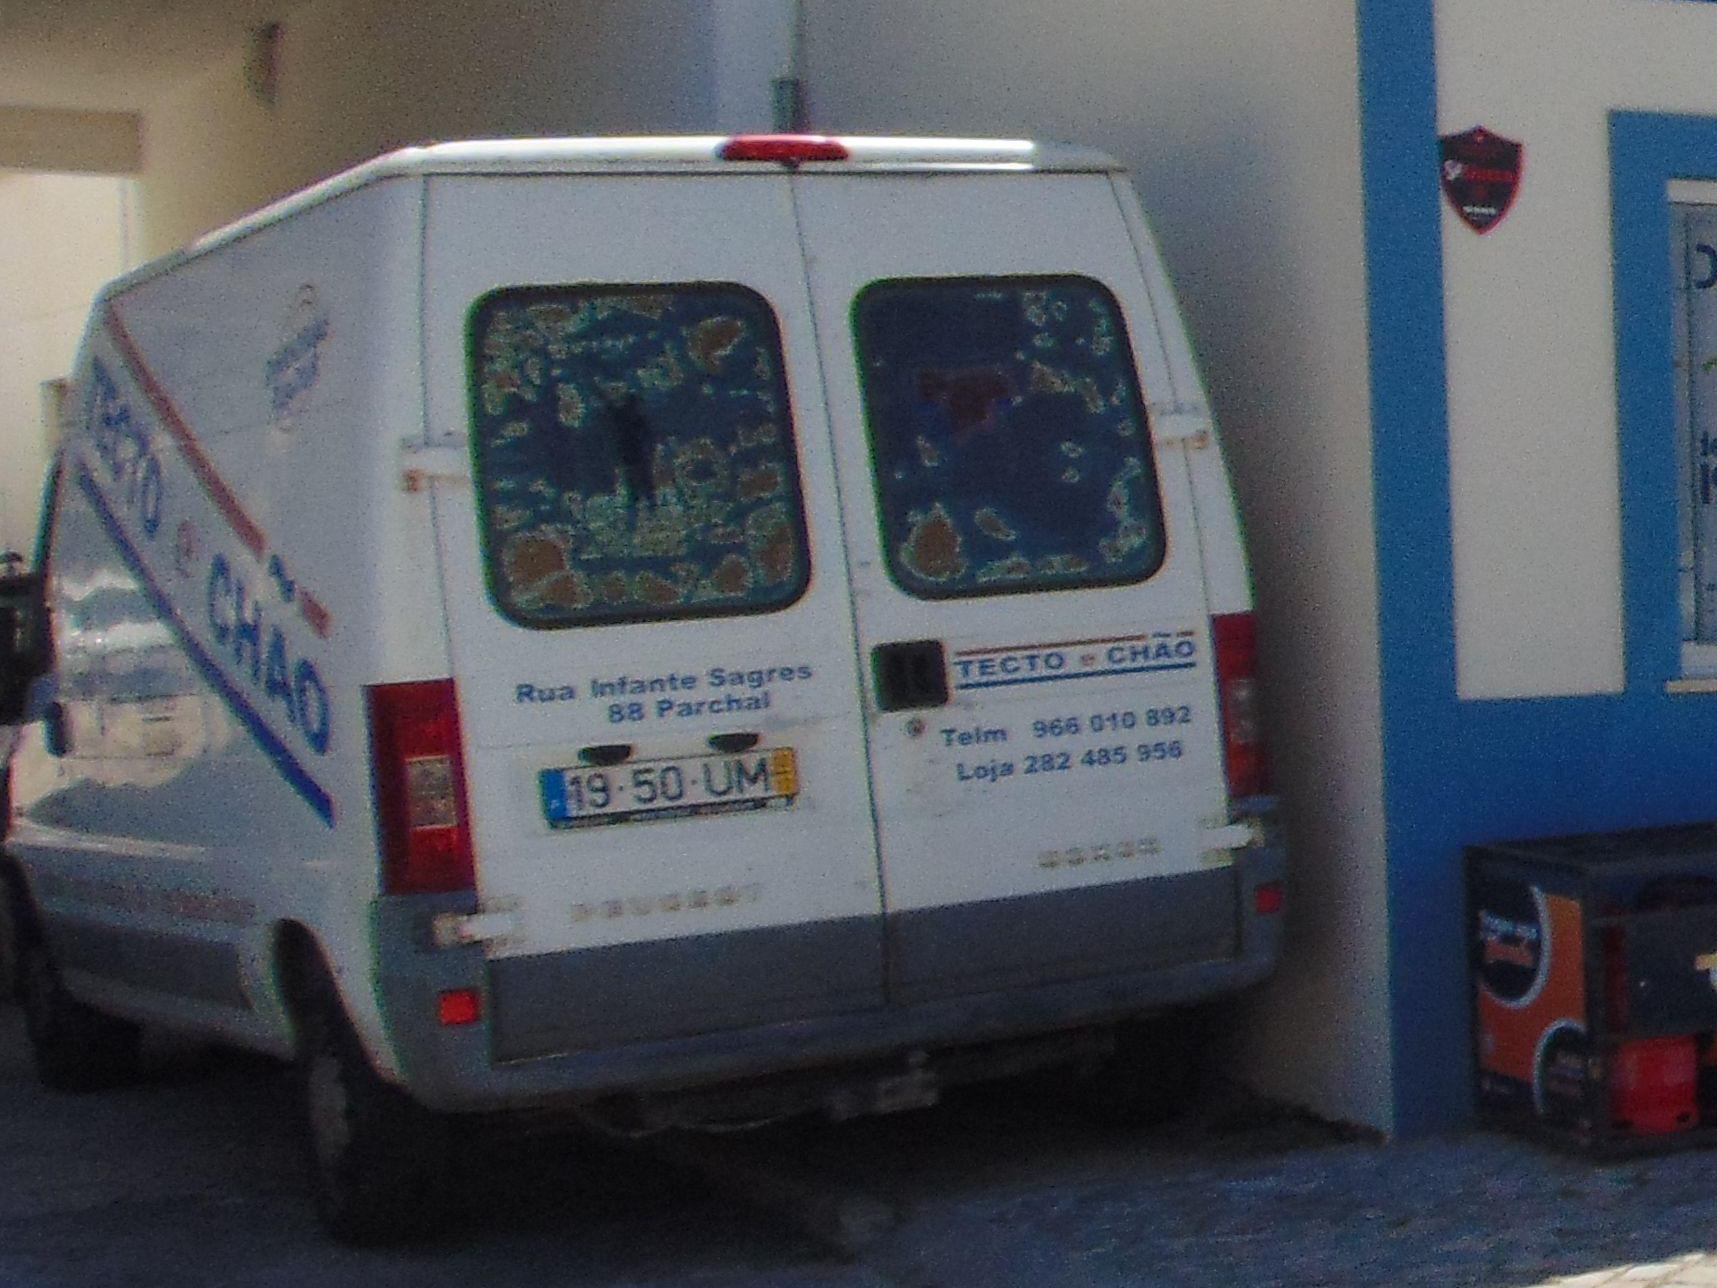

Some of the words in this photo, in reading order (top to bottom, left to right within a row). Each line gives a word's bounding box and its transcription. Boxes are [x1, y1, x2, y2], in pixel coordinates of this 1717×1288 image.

[953, 651, 1065, 680] TECTO
[1106, 631, 1197, 666] CHÃO
[515, 682, 576, 704] Rua
[590, 672, 697, 699] Infante
[709, 663, 813, 690] Sagres
[607, 701, 645, 725] 88
[656, 691, 772, 719] Parchal
[941, 726, 1009, 748] Telm
[1032, 716, 1080, 739] 966
[1089, 710, 1137, 733] 010
[956, 762, 1015, 784] Loja
[1023, 751, 1072, 776] 282
[1080, 745, 1128, 767] 485
[1136, 739, 1184, 762] 956
